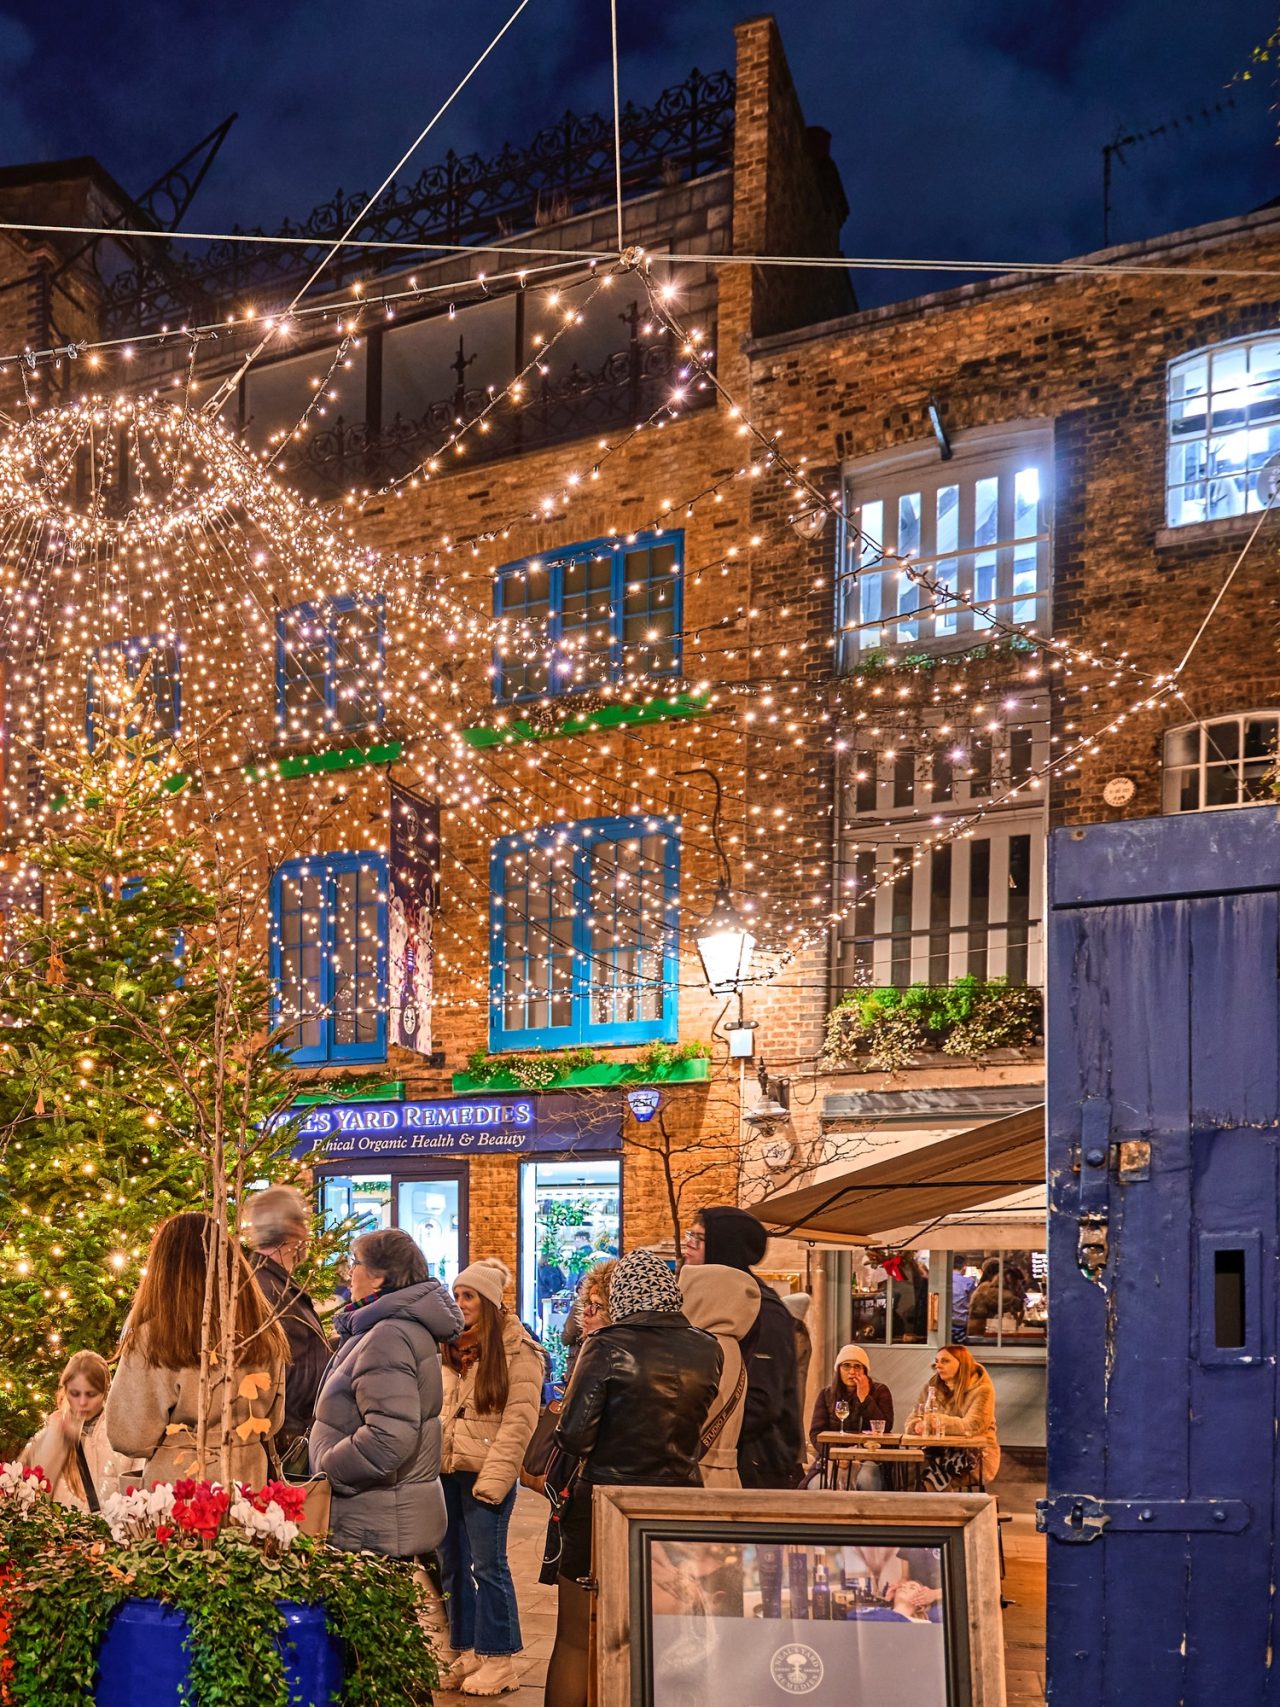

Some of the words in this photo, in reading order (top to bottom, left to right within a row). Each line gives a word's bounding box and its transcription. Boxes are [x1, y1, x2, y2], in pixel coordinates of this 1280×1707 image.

[336, 1108, 397, 1130] YARD
[402, 1103, 530, 1128] REMEDIES
[358, 1136, 408, 1152] Organic
[411, 1134, 454, 1148] Health
[458, 1133, 475, 1146] &
[478, 1132, 526, 1148] Beauty
